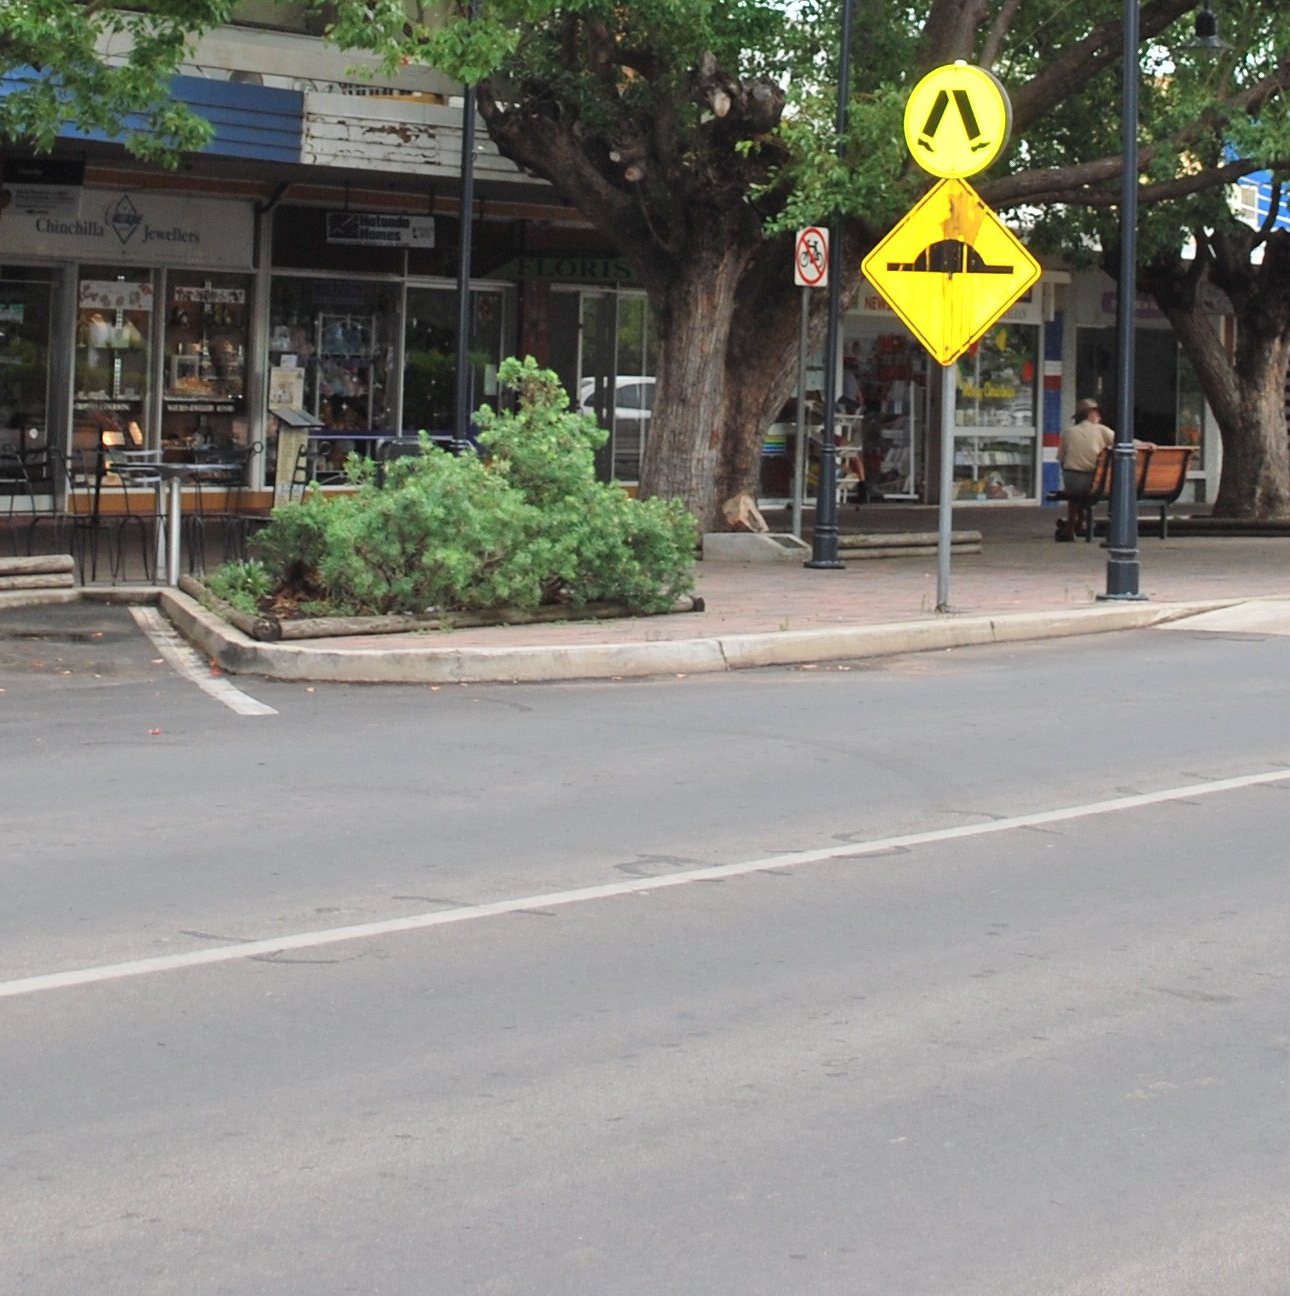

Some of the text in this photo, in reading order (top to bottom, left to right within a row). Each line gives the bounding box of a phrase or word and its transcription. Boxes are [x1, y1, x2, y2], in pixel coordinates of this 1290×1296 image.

[35, 217, 105, 237] Chinchilla
[142, 224, 200, 244] Jewellers
[360, 228, 402, 242] Homes
